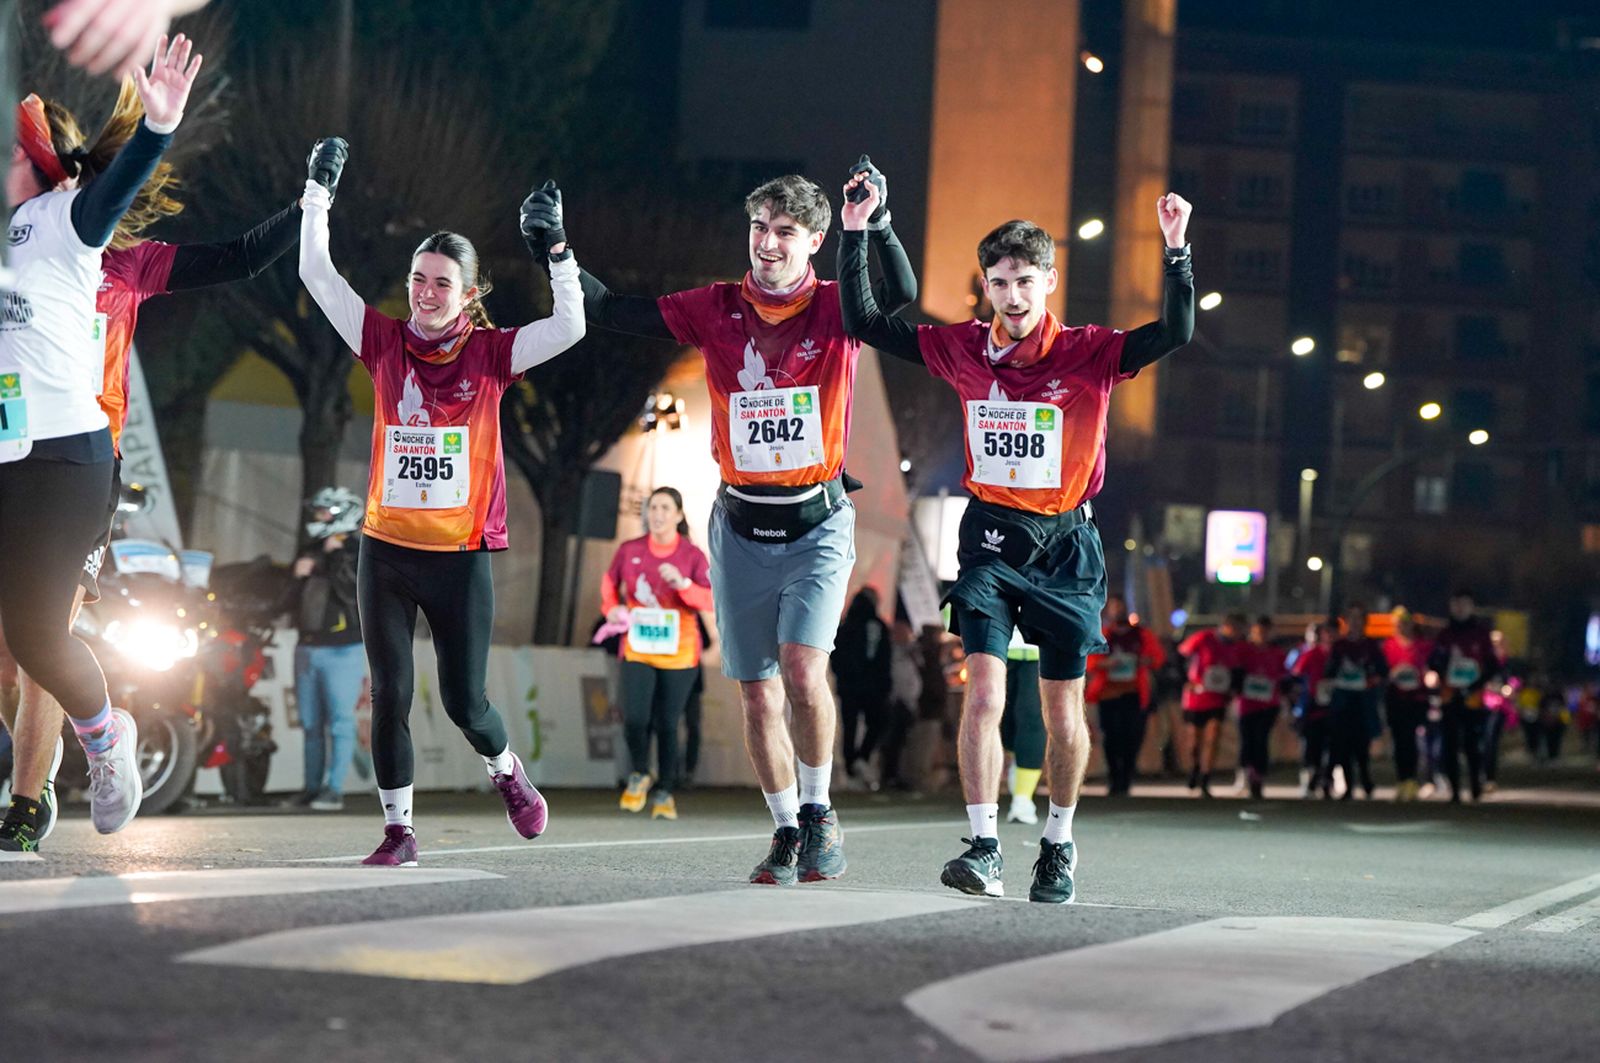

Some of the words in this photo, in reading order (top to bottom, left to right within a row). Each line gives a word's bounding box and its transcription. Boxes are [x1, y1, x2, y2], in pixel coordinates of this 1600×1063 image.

[748, 398, 772, 408] NOCHE
[775, 398, 785, 407] DE
[740, 411, 756, 420] SAN
[757, 407, 786, 419] ANTÓN
[988, 410, 1014, 420] NOCHE
[1016, 412, 1027, 420] DE
[978, 420, 995, 430] SAN
[997, 420, 1027, 431] ANTÓN
[748, 418, 805, 445] 2642
[402, 434, 424, 445] NOCHE
[426, 435, 435, 445] DE
[984, 431, 1045, 459] 5398
[393, 444, 408, 454] SAN
[409, 444, 436, 455] ANTÓN
[397, 456, 454, 481] 2595
[753, 527, 787, 538] Reebok
[980, 542, 1002, 553] adidas
